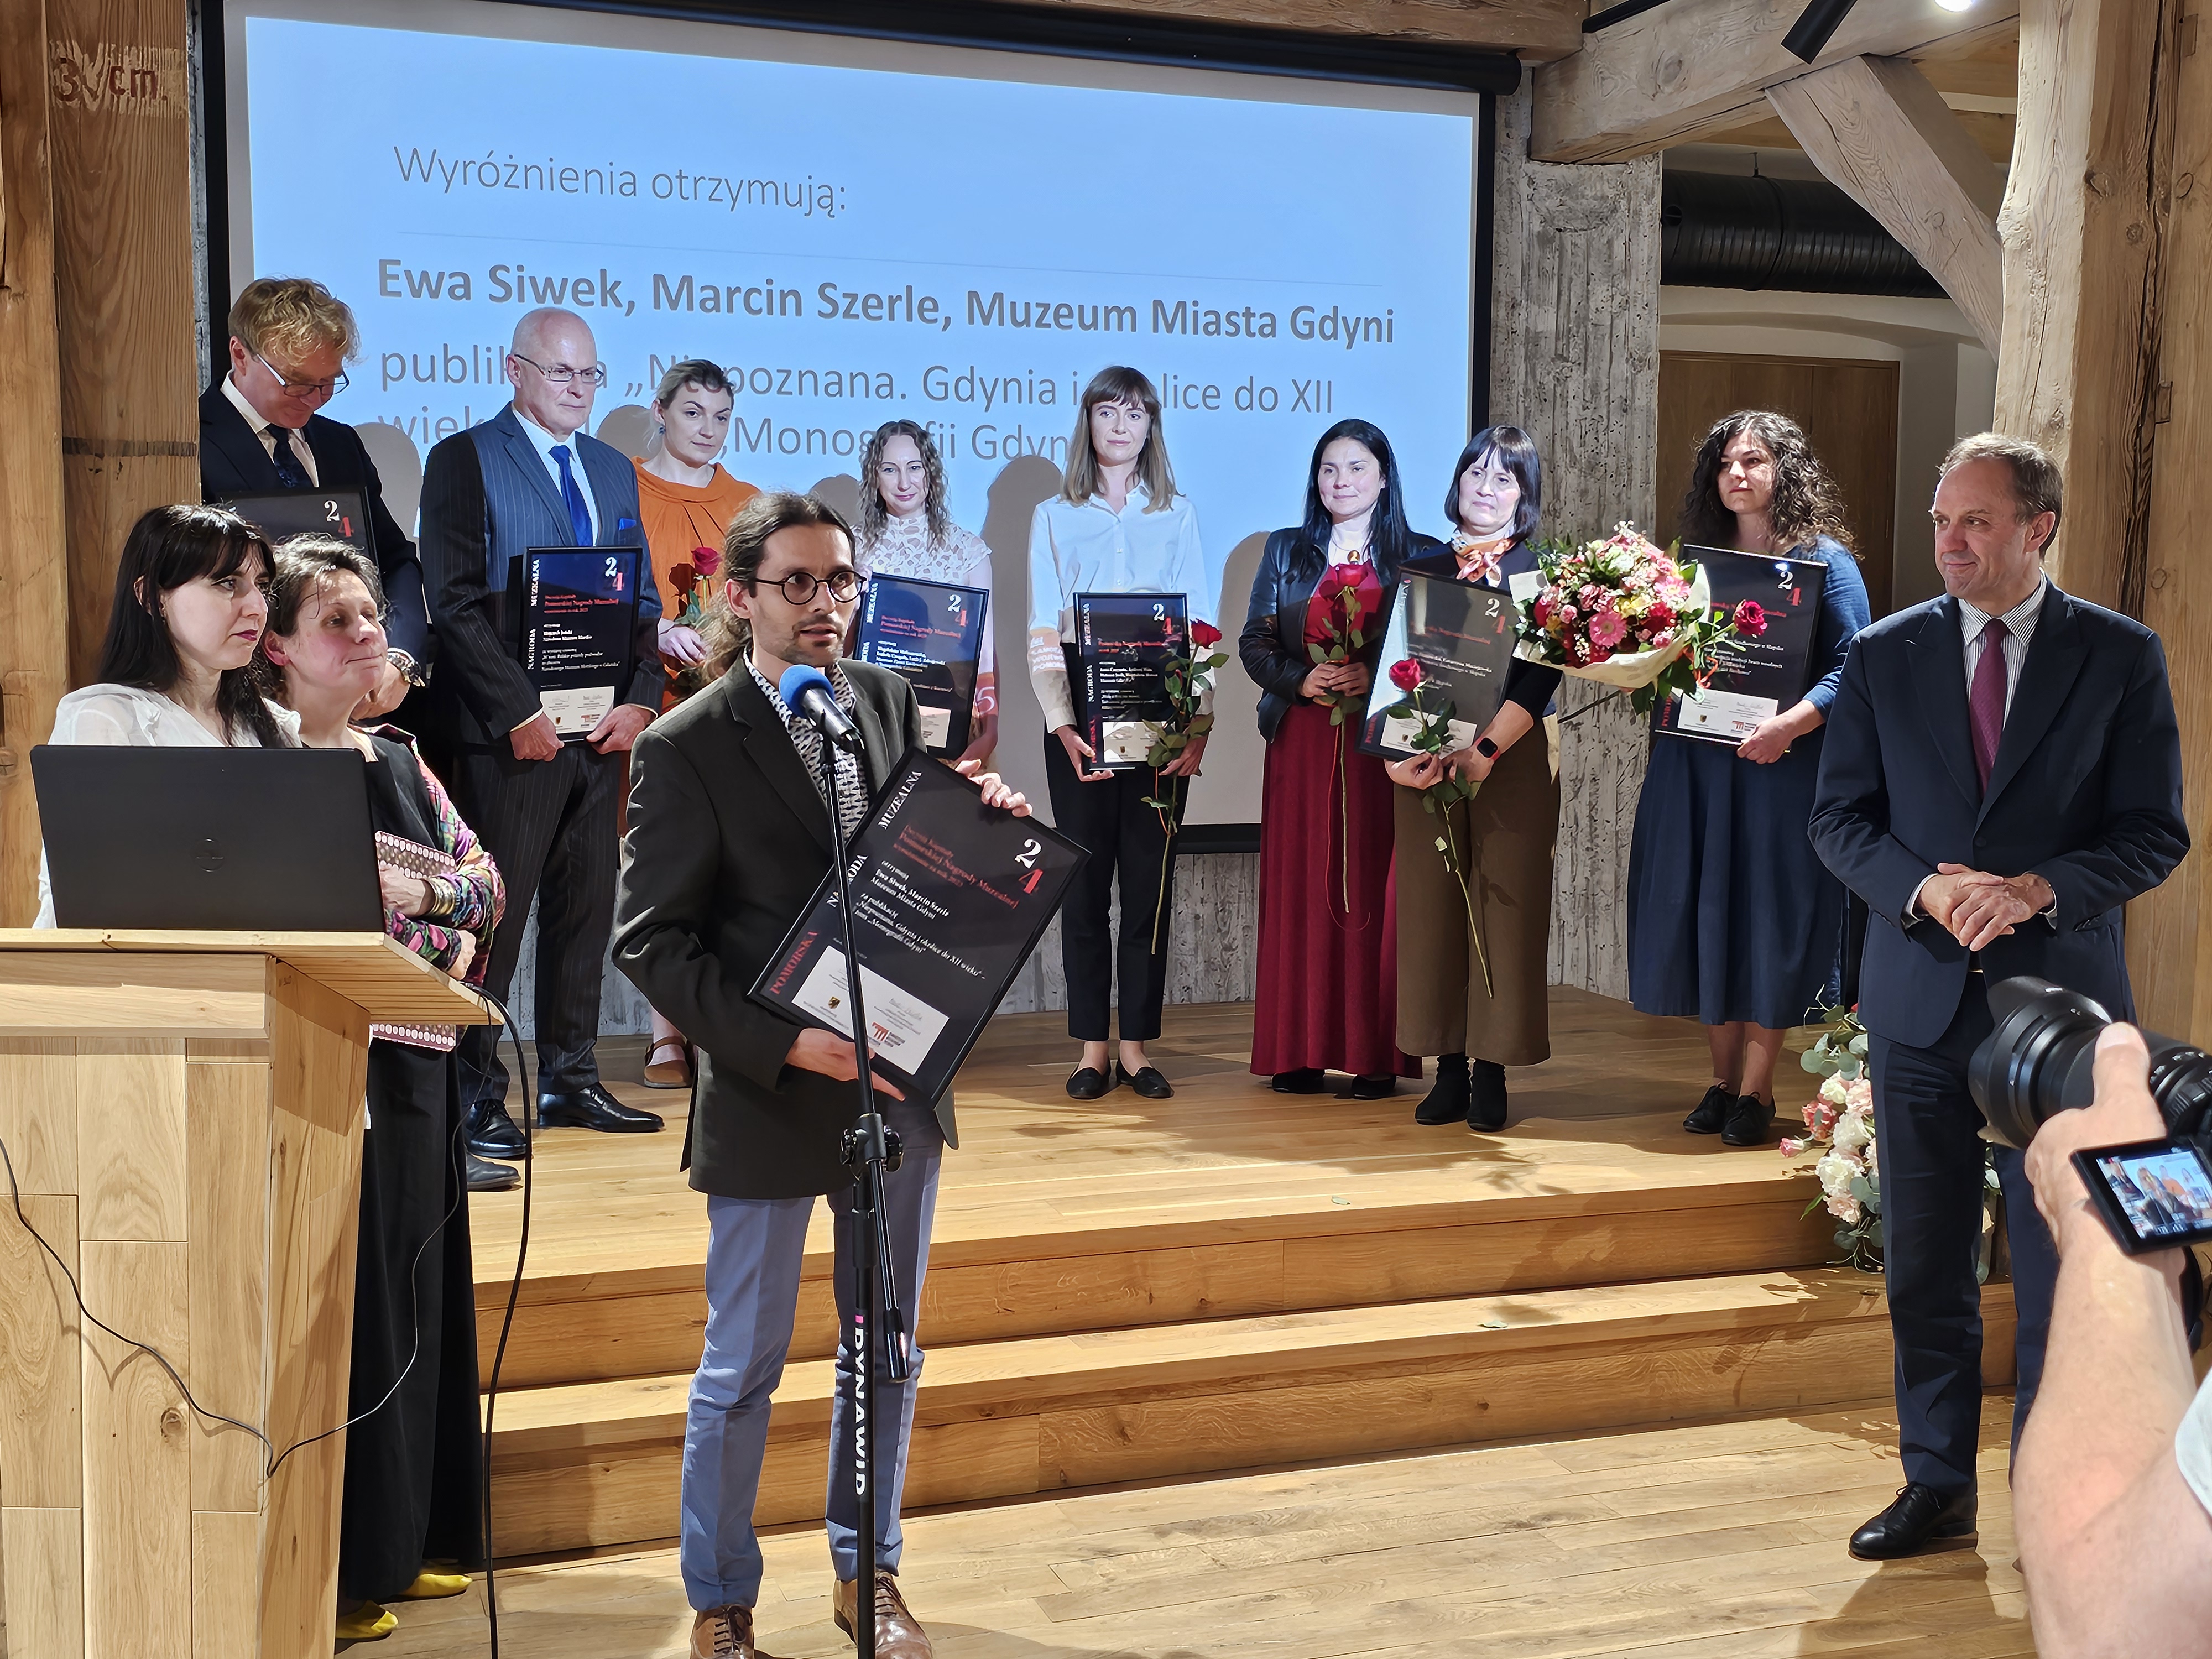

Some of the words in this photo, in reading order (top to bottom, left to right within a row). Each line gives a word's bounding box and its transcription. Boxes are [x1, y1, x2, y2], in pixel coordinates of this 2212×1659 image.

[394, 146, 637, 197] Wyróżnienia
[652, 169, 845, 218] otrzymują:
[379, 259, 471, 301] Ewa
[488, 264, 635, 317] Siwek,
[653, 273, 802, 317] Marcin
[817, 282, 951, 332] Szerle,
[967, 290, 1136, 332] Muzeum
[1152, 299, 1276, 338] Miasta
[1290, 305, 1394, 351] Gdyni
[922, 365, 1056, 413] Gdynia
[1234, 375, 1279, 412] do
[1291, 379, 1332, 413] XII
[972, 424, 1068, 462] Gdyn
[324, 500, 340, 521] 2
[338, 517, 354, 538] 4
[530, 559, 540, 607] MUZEALNA
[605, 557, 617, 577] 2
[612, 572, 624, 591] 4
[1777, 571, 1793, 590] 2
[1786, 587, 1802, 606] 4
[948, 594, 961, 612] 2
[954, 609, 968, 627] 4
[1153, 603, 1165, 621] 2
[1484, 598, 1500, 618] 2
[527, 628, 536, 670] NAGRODA
[1086, 665, 1094, 702] NAGRODA
[877, 769, 922, 829] MUZEALNA
[1014, 839, 1042, 869] 2
[1018, 868, 1044, 894] 4
[854, 1327, 867, 1496] DYNAWID
